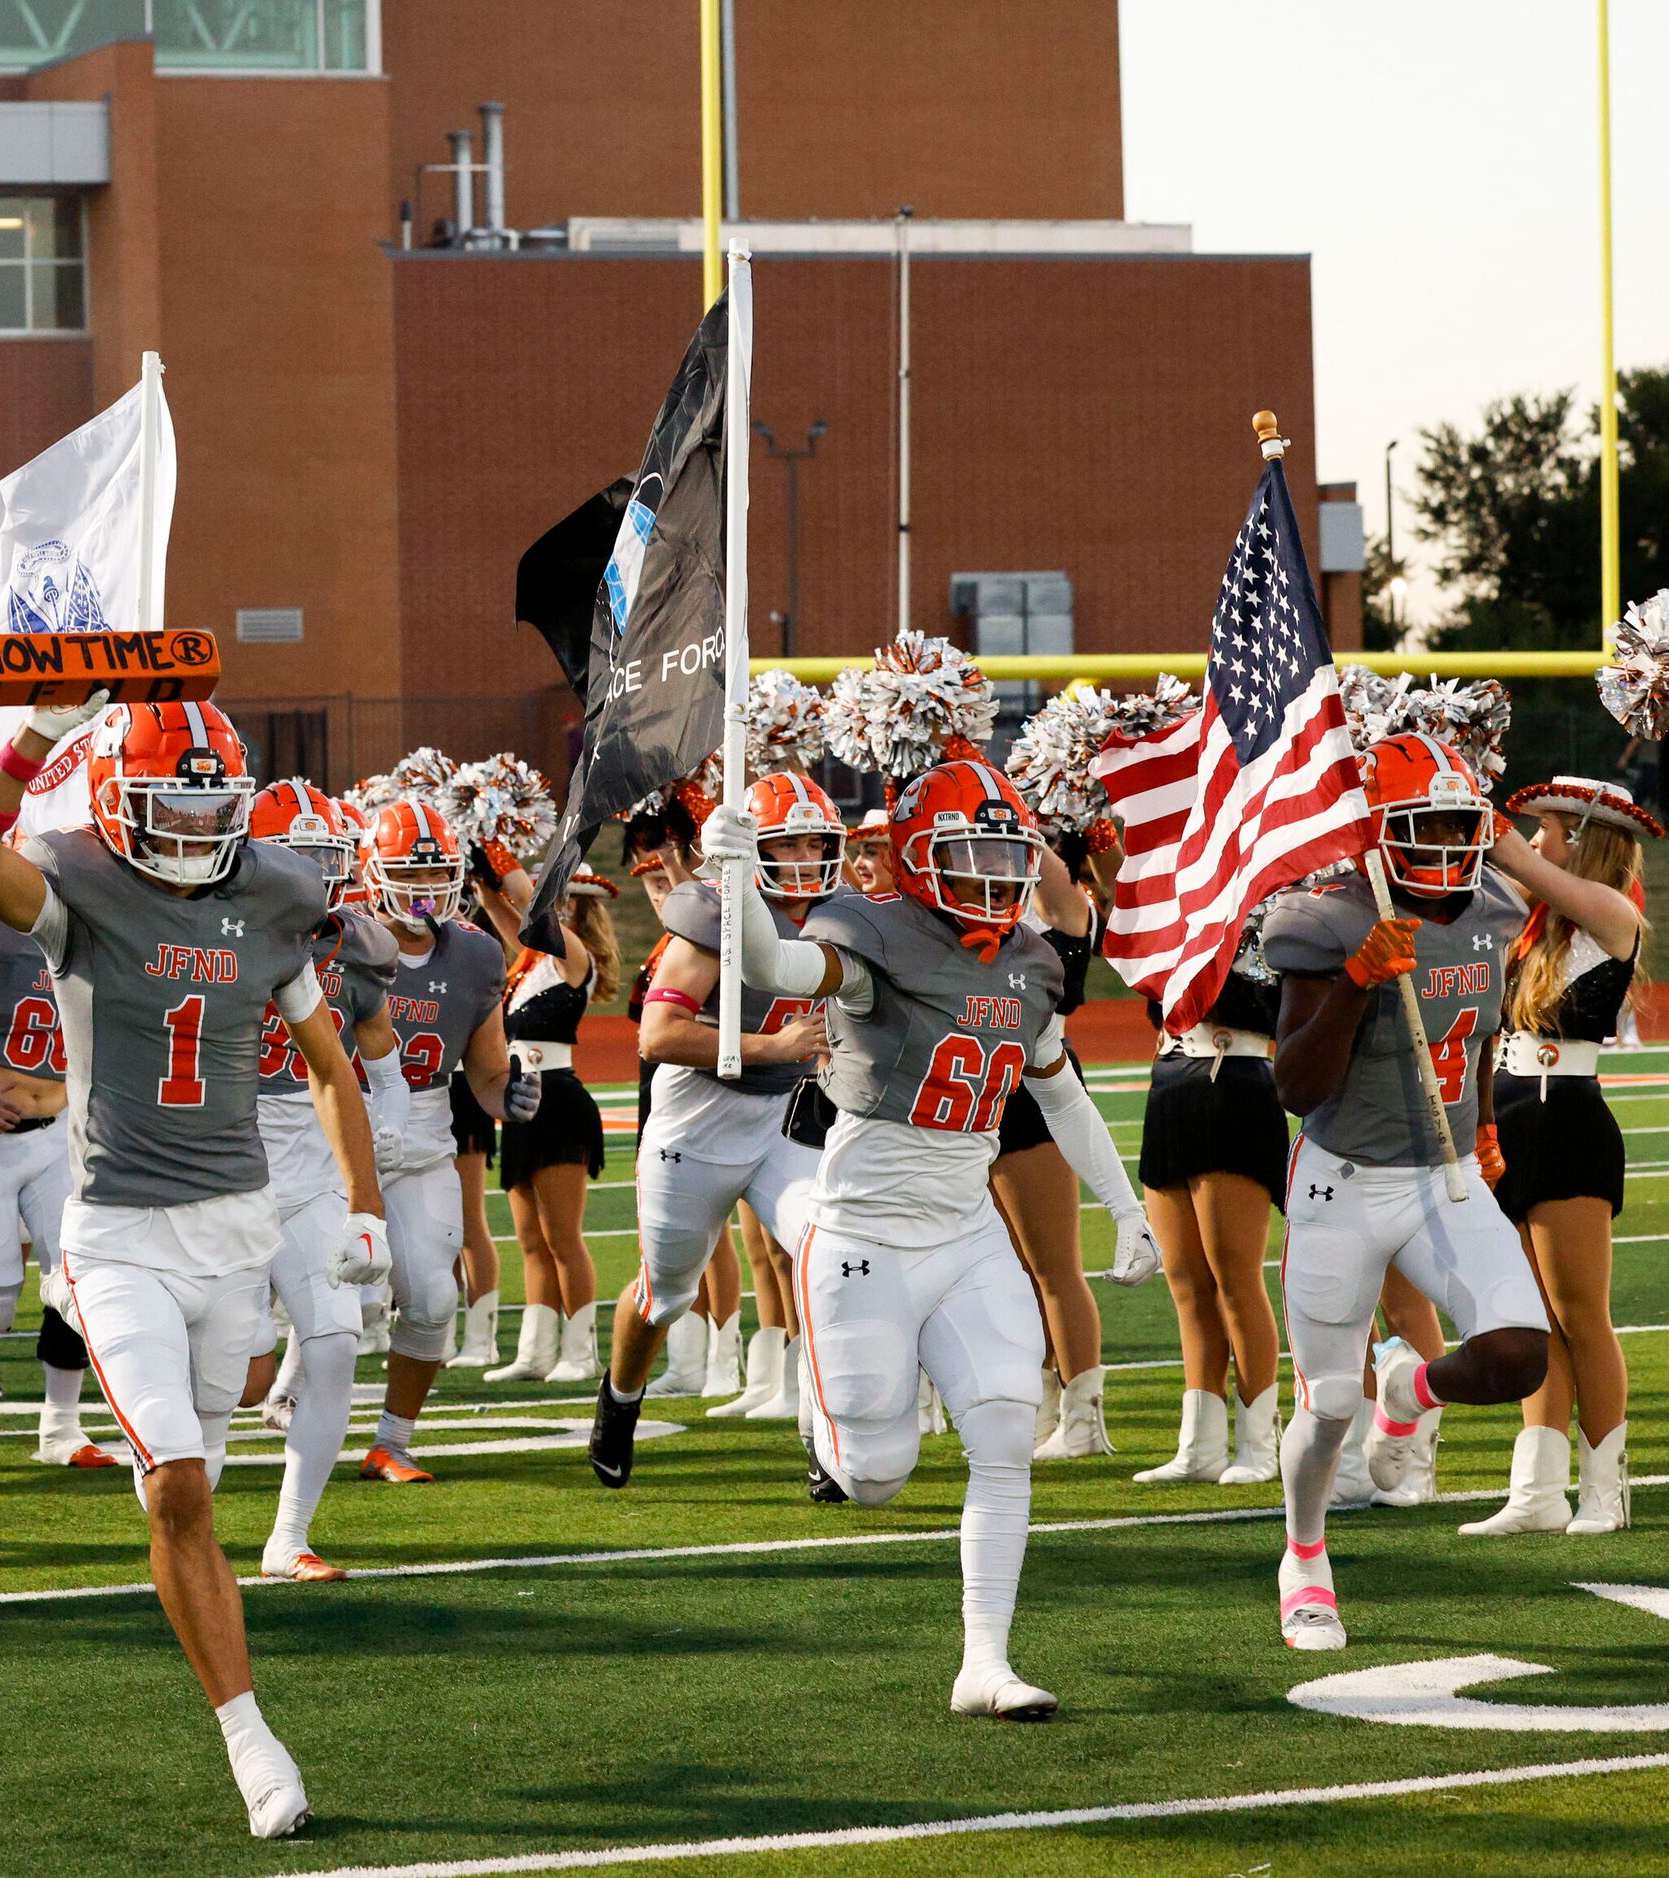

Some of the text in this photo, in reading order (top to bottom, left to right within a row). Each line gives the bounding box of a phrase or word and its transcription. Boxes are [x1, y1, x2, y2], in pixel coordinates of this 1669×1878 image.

[28, 737, 91, 793] UNITED ST
[937, 812, 960, 822] NXTRND
[723, 906, 732, 940] SPACE
[145, 943, 238, 984] JFND
[1421, 961, 1490, 999] JFND
[956, 995, 1022, 1030] JFND
[157, 993, 207, 1108] 1
[1418, 1006, 1480, 1105] 4
[907, 1031, 1027, 1133] 60
